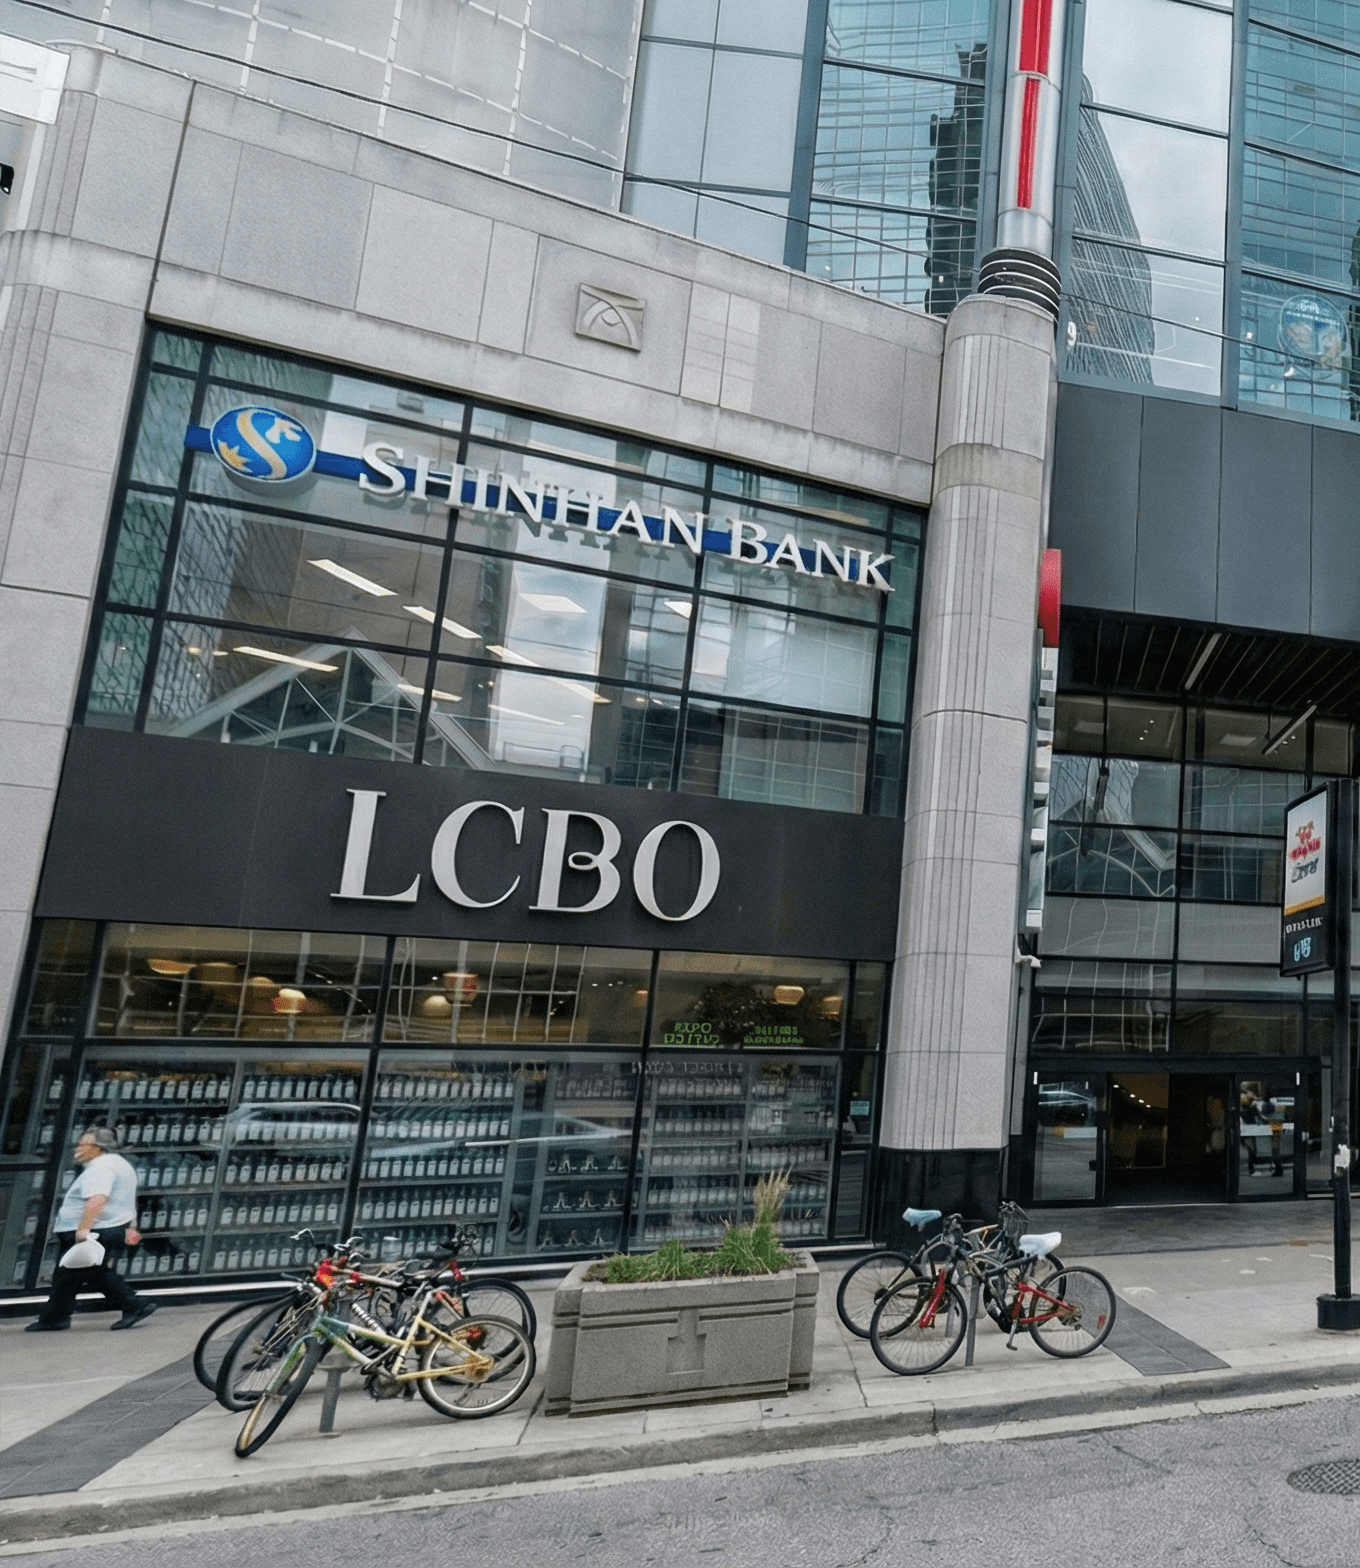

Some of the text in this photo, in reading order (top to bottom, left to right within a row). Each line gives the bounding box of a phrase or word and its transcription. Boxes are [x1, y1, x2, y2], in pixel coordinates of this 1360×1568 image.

[358, 441, 896, 593] SHINHAN BANK
[330, 788, 720, 922] LCBO
